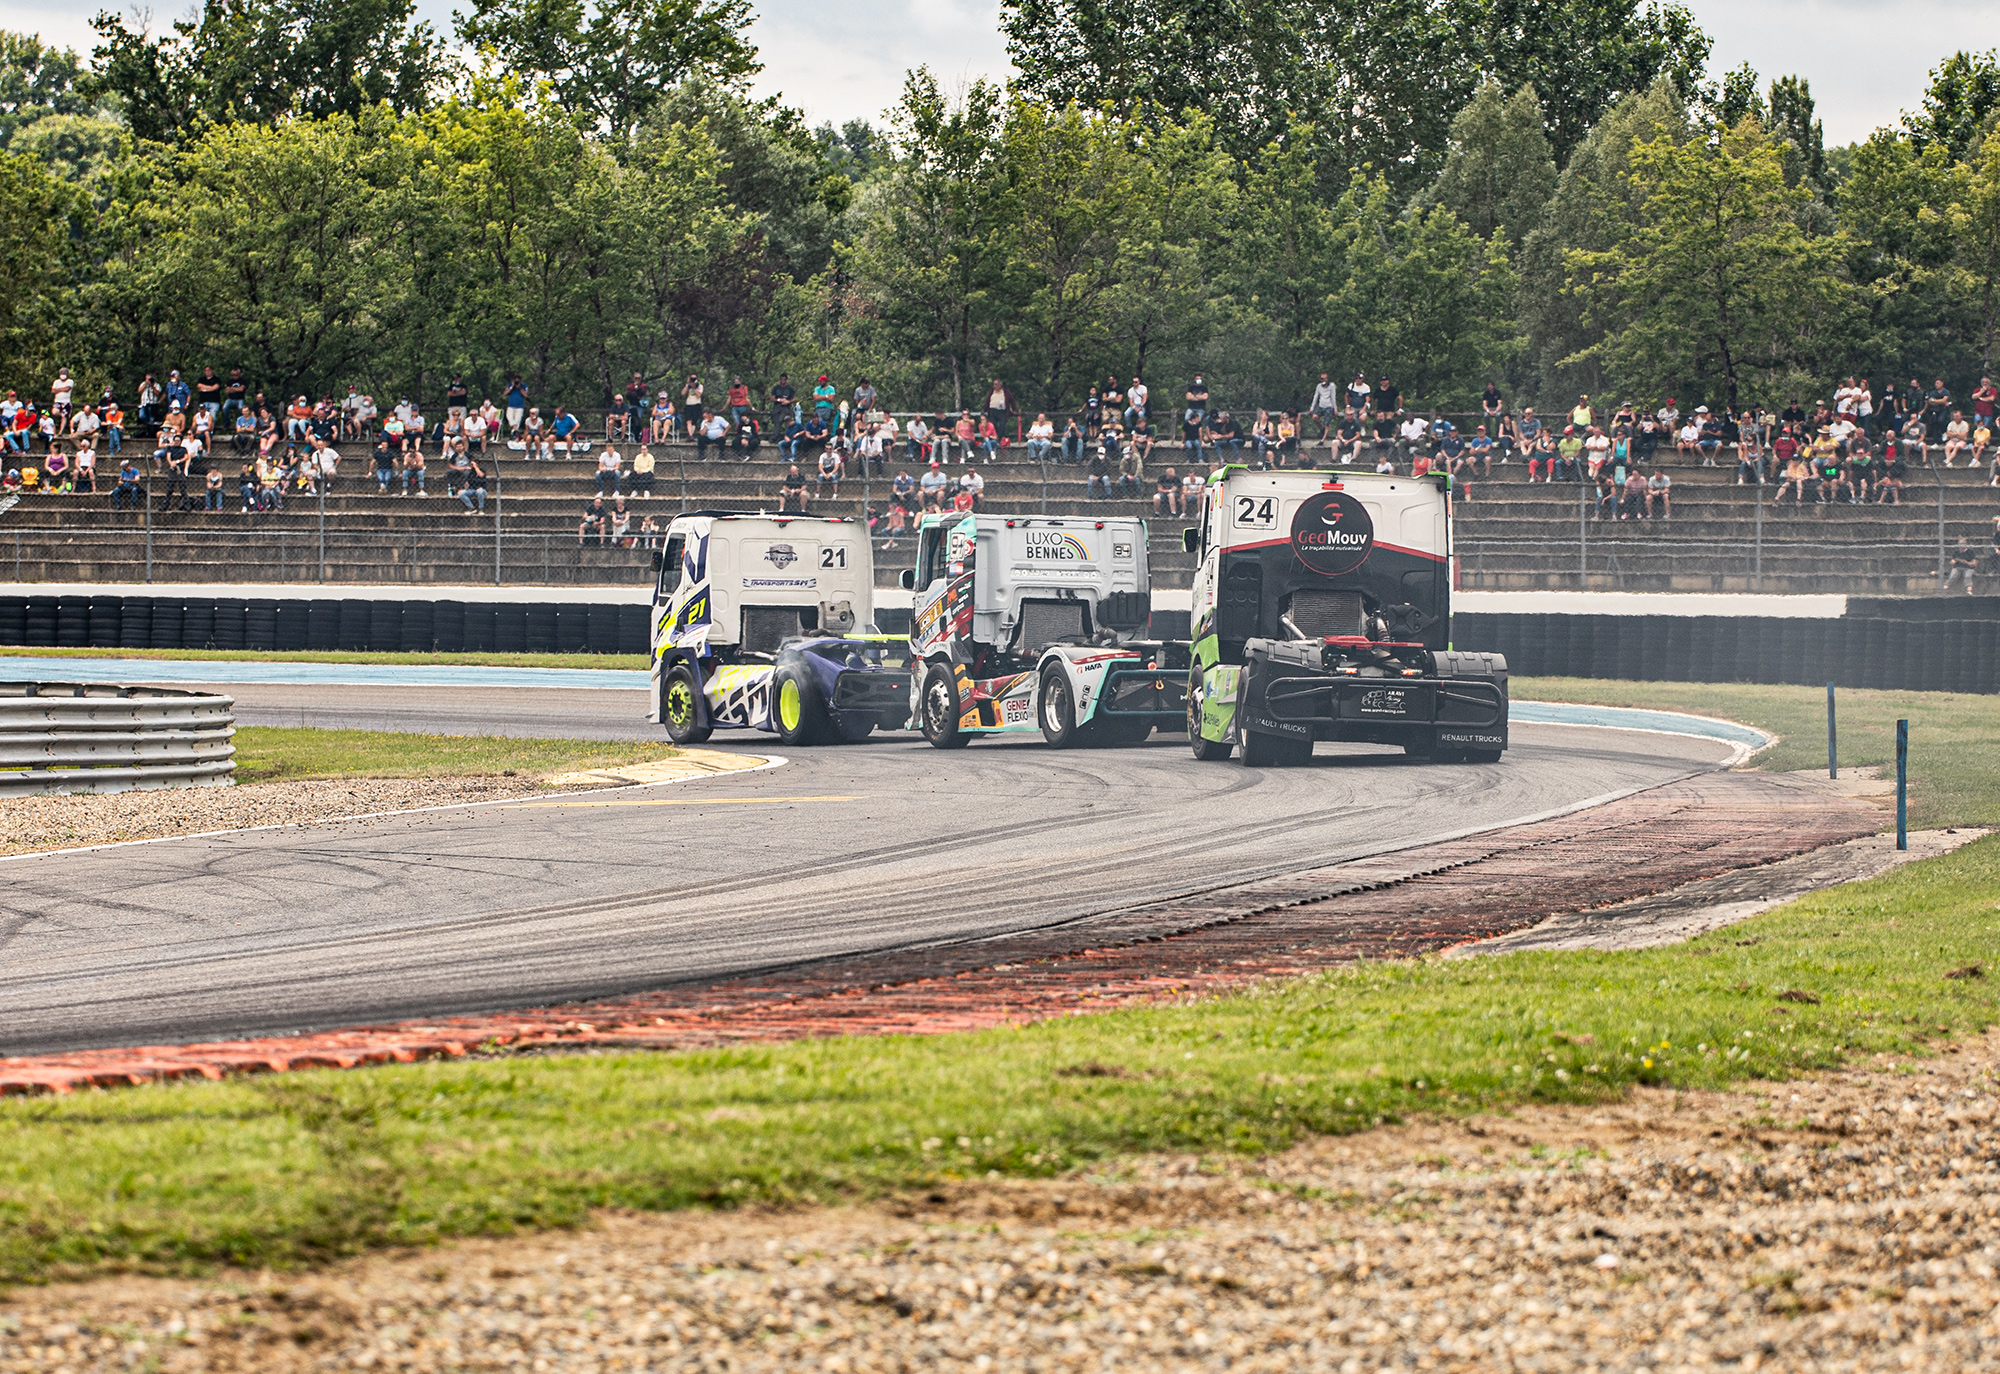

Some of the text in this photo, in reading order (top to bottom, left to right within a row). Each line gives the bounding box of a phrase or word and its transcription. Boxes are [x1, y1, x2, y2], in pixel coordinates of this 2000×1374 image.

[1238, 498, 1274, 524] 24
[1026, 532, 1063, 546] LUXO
[1298, 529, 1368, 546] GedMouv
[821, 548, 845, 568] 21
[1026, 547, 1074, 560] BENNES
[1114, 546, 1130, 556] 94
[687, 597, 706, 625] 21
[1441, 734, 1503, 744] RENAULT TRUCKS
